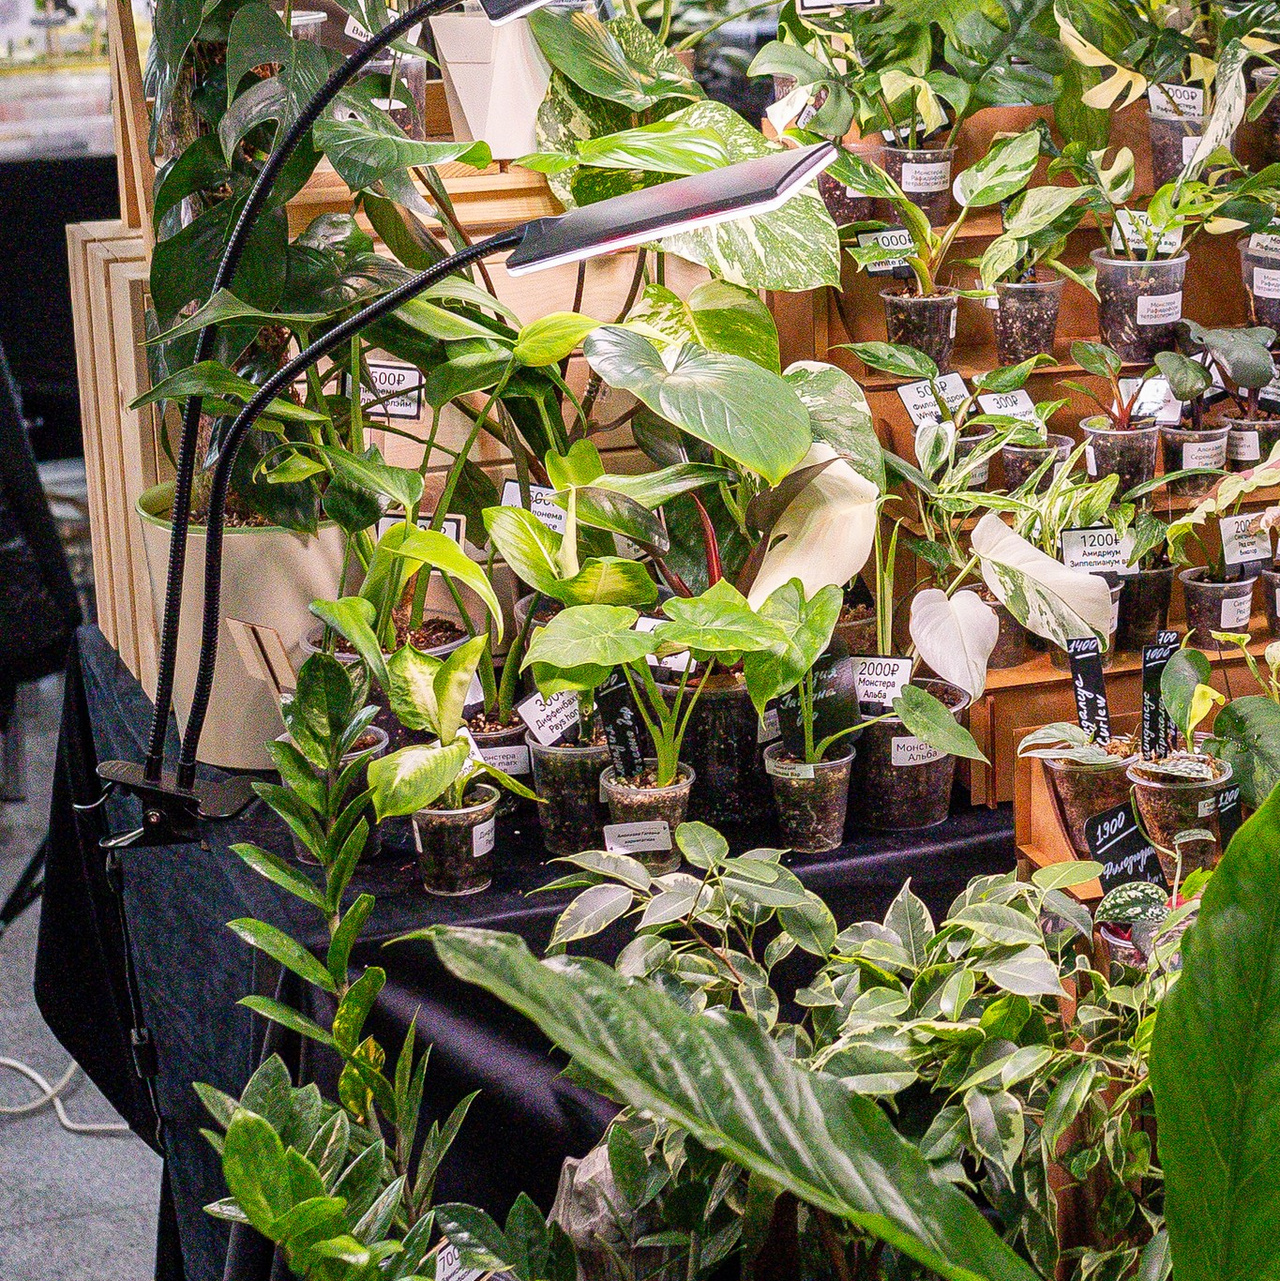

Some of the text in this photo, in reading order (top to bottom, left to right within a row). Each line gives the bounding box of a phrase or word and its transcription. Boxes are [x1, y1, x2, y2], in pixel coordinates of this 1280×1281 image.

[1161, 88, 1197, 101] 000₽
[1082, 549, 1121, 559] Амидриум
[1070, 557, 1121, 569] Зиппелианум
[1158, 632, 1177, 645] 700
[1069, 640, 1098, 654] 1400
[859, 662, 899, 677] 2000₽
[858, 677, 895, 689] Монстера
[863, 690, 887, 700] Альба
[908, 750, 938, 763] Альба
[1096, 811, 1126, 846] 1900
